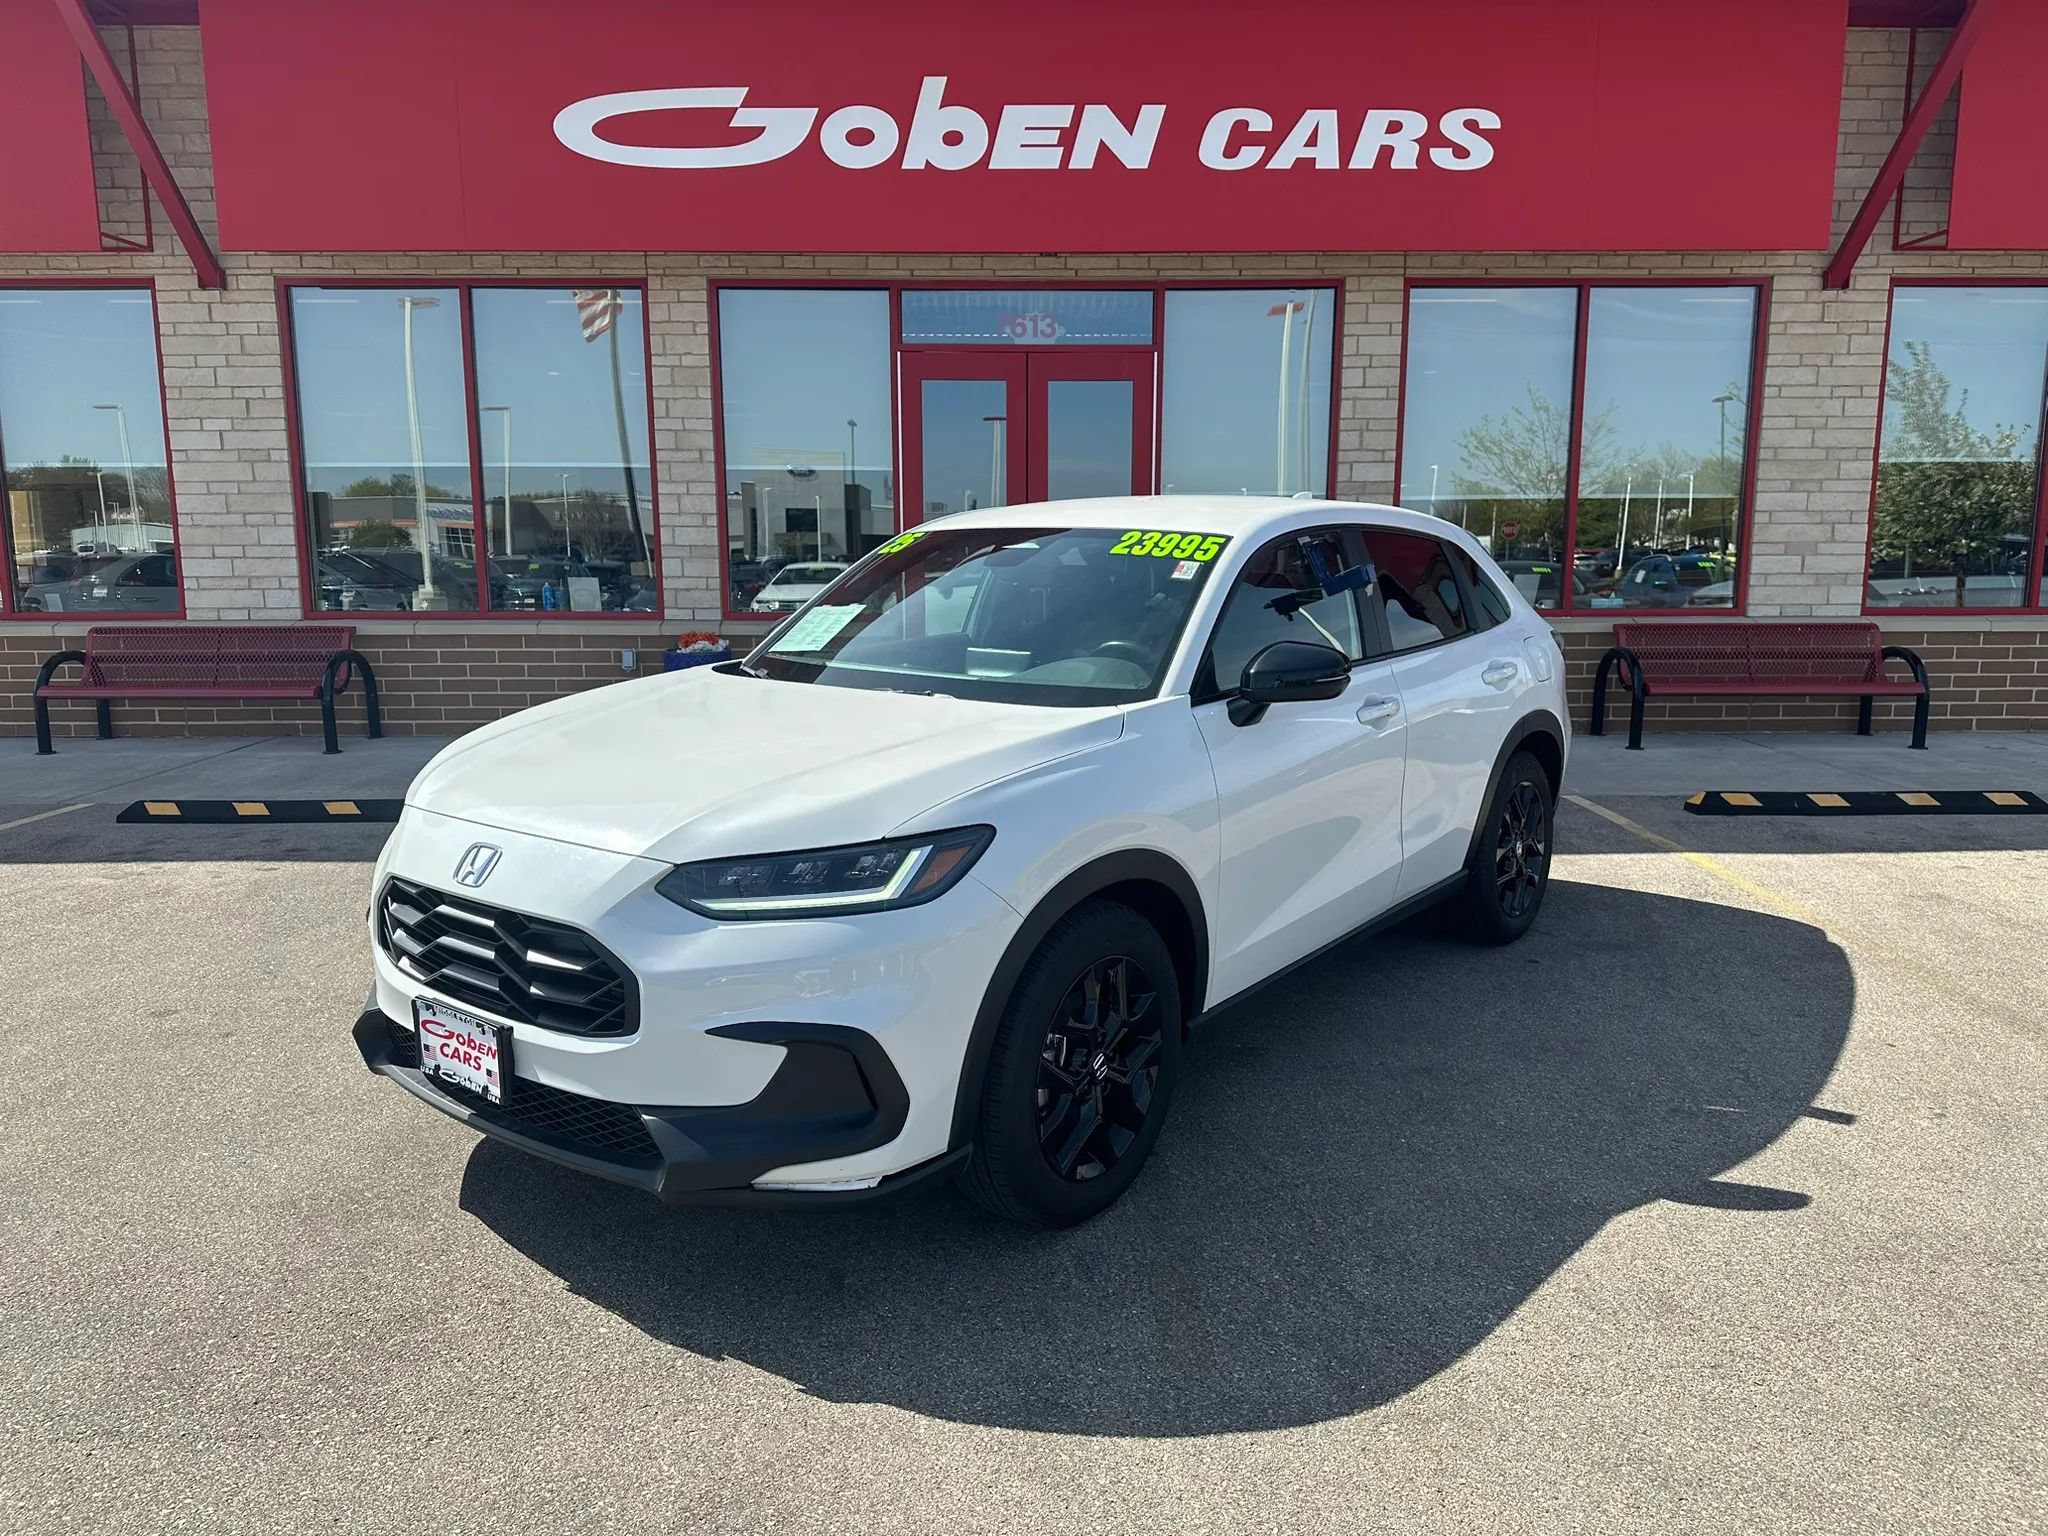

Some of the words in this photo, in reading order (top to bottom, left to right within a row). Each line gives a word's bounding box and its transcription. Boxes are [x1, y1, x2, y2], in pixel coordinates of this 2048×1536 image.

[1198, 107, 1502, 170] CARS
[1110, 530, 1226, 561] 23995
[439, 1042, 482, 1072] CARS
